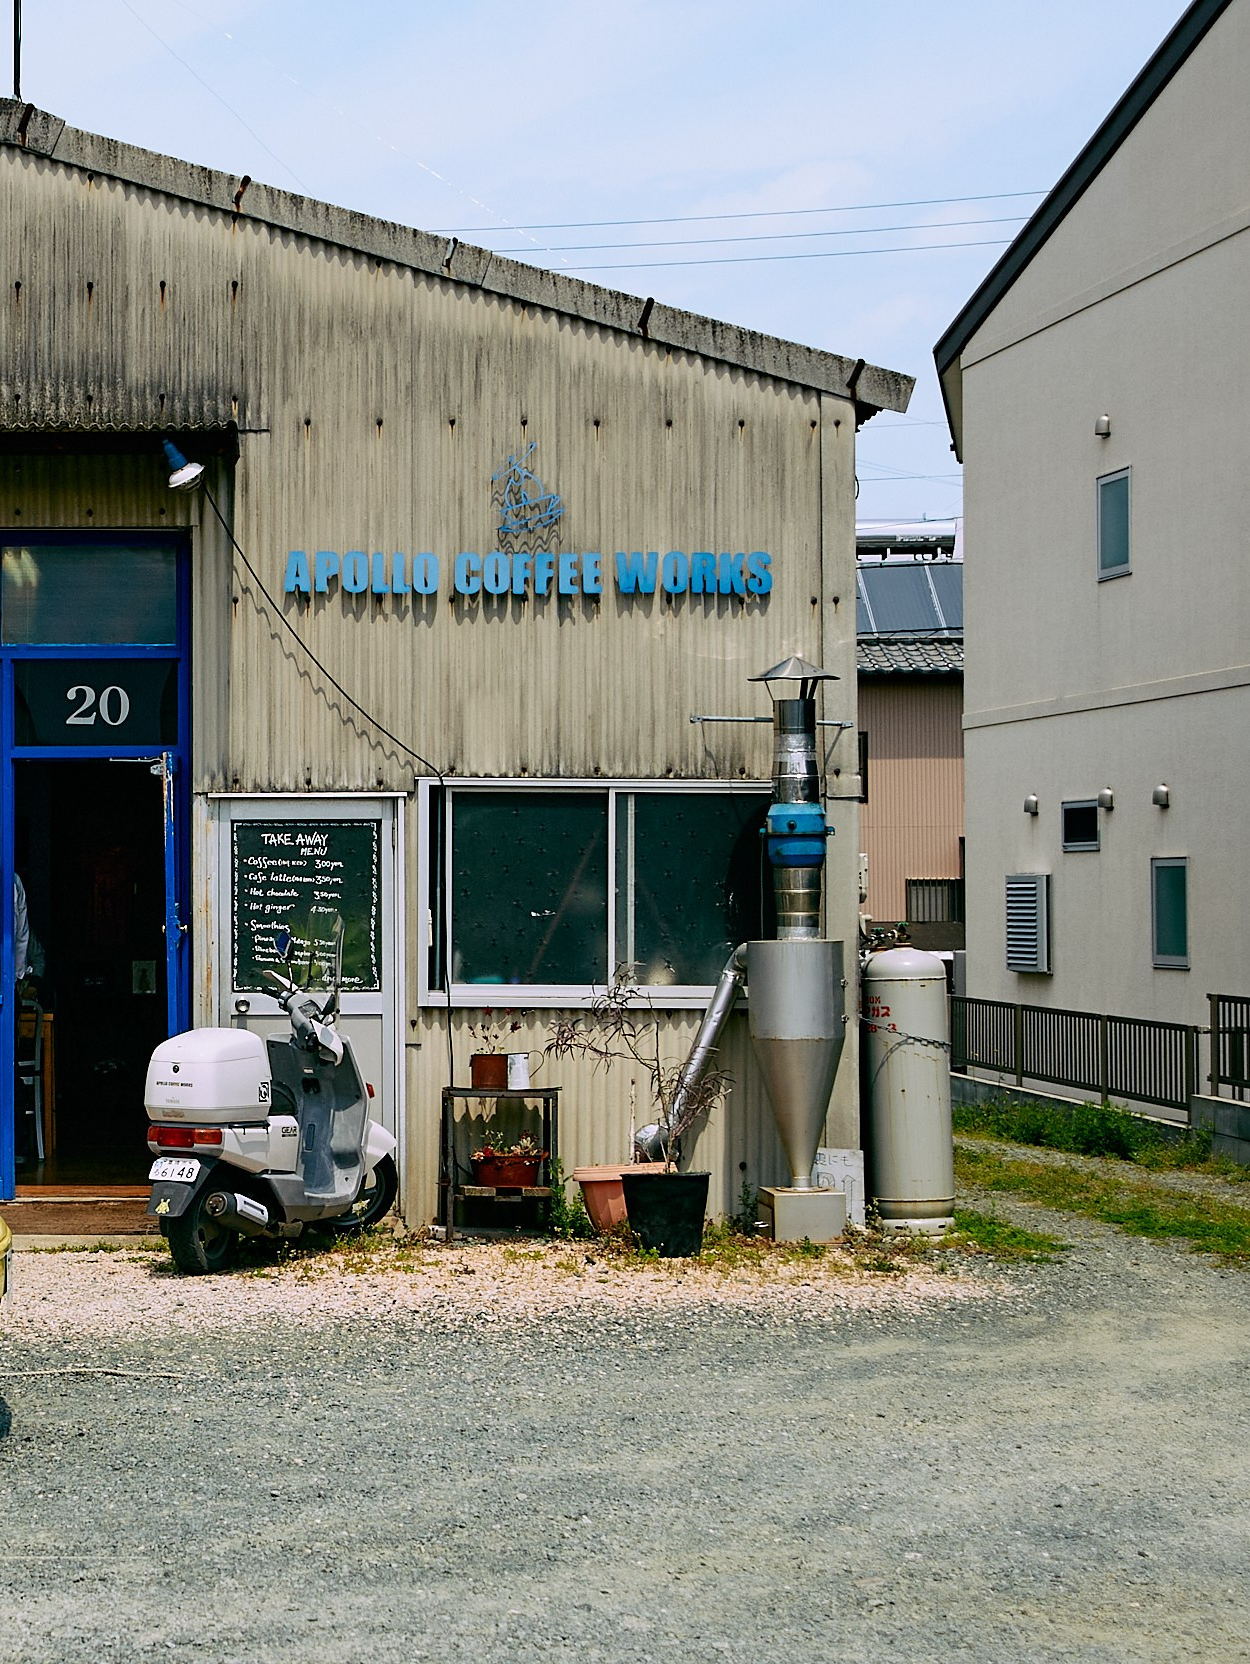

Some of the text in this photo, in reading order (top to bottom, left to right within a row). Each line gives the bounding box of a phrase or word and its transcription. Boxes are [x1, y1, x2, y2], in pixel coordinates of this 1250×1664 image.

[284, 551, 773, 594] APOLLO COFFEE WORKS
[66, 686, 130, 725] 20
[261, 831, 329, 846] TAKE AWAY
[300, 847, 328, 856] MENU
[250, 888, 264, 897] Hot
[250, 903, 263, 911] Hot
[265, 904, 295, 914] ginger
